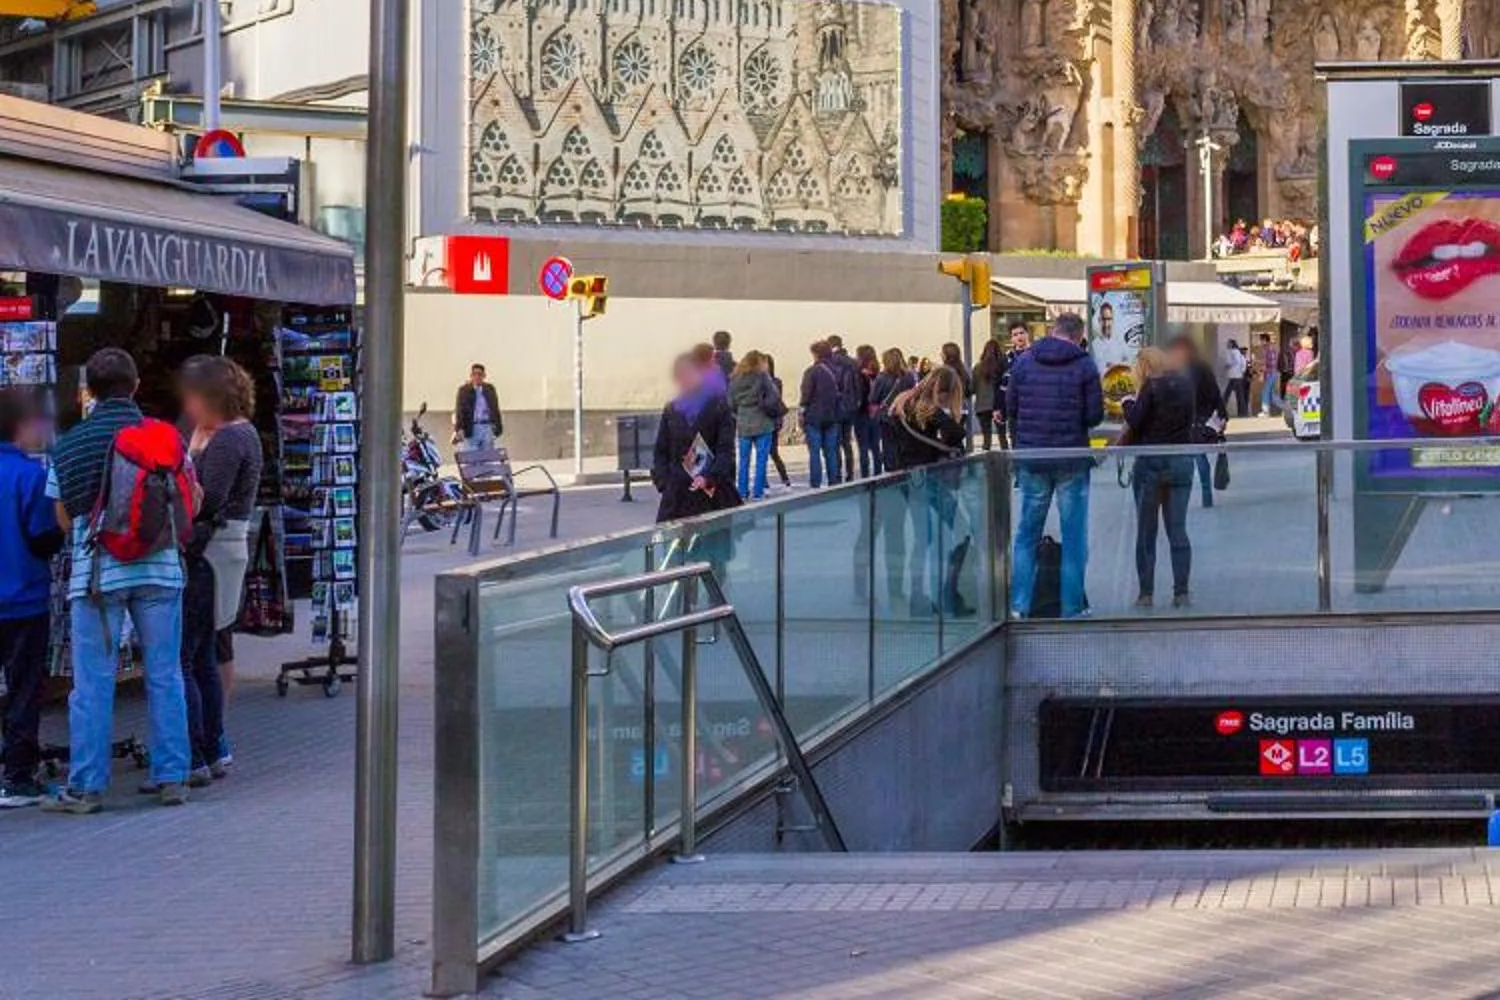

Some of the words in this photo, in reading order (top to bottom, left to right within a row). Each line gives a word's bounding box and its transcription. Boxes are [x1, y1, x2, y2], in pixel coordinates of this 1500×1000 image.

[1413, 121, 1467, 136] Sagrada
[1451, 159, 1500, 173] Sagrada
[1371, 197, 1423, 232] NUEVO
[67, 220, 101, 273] LA
[104, 227, 271, 294] VANGUARDIA
[1249, 712, 1335, 734] Sagrada
[1341, 711, 1415, 730] Família
[1300, 747, 1329, 767] L2
[1337, 747, 1365, 767] L5
